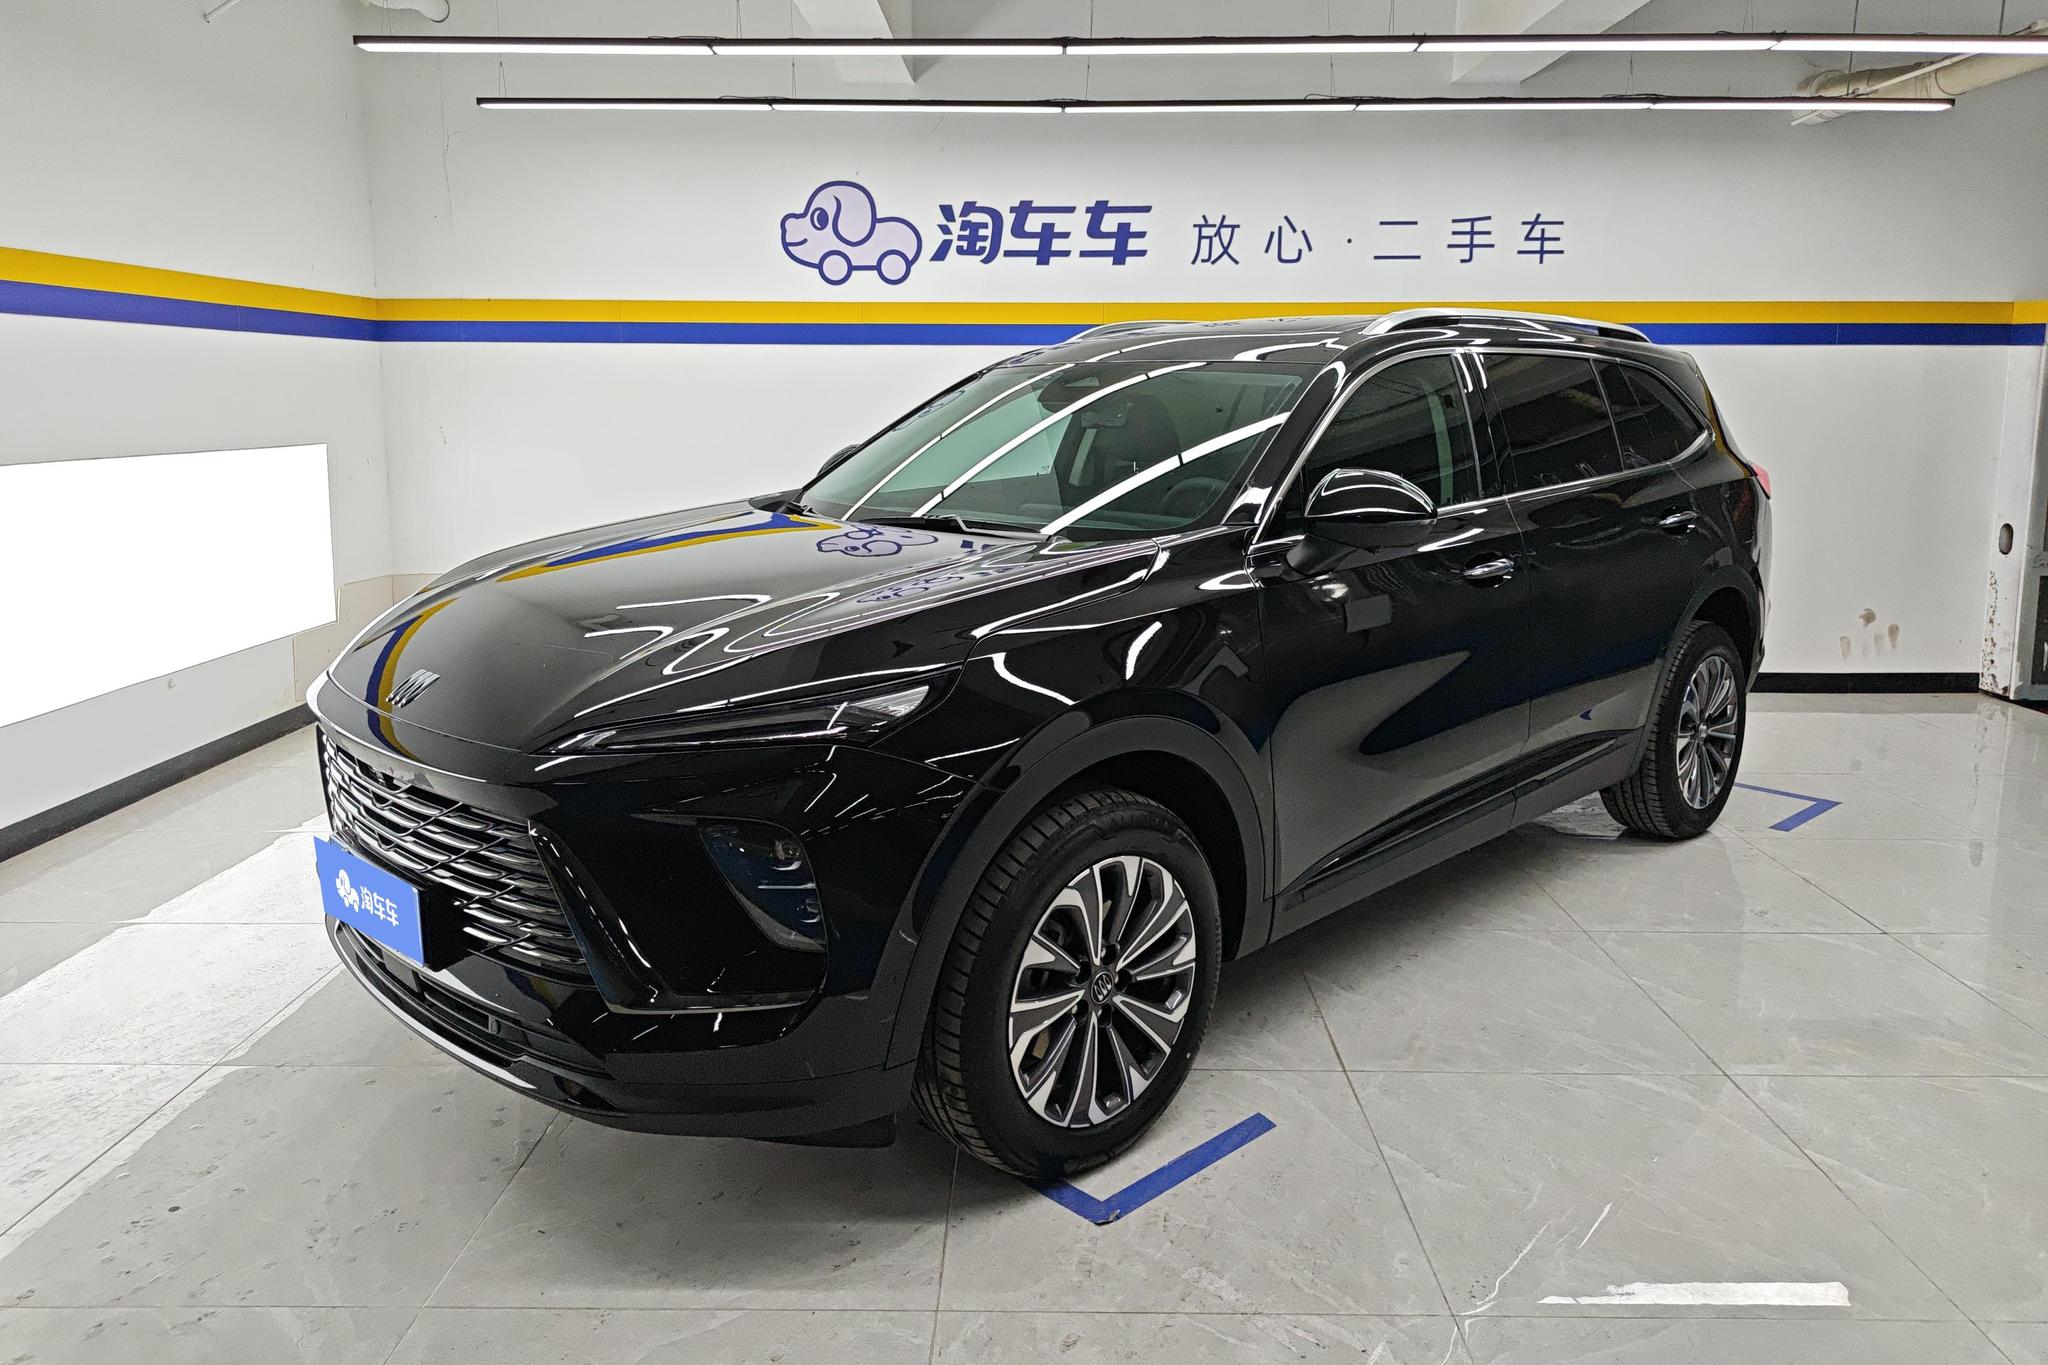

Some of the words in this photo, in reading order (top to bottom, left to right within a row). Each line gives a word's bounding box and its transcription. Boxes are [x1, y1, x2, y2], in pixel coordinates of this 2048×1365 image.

[929, 199, 1153, 266] 淘车车
[360, 885, 399, 927] 淘车车
